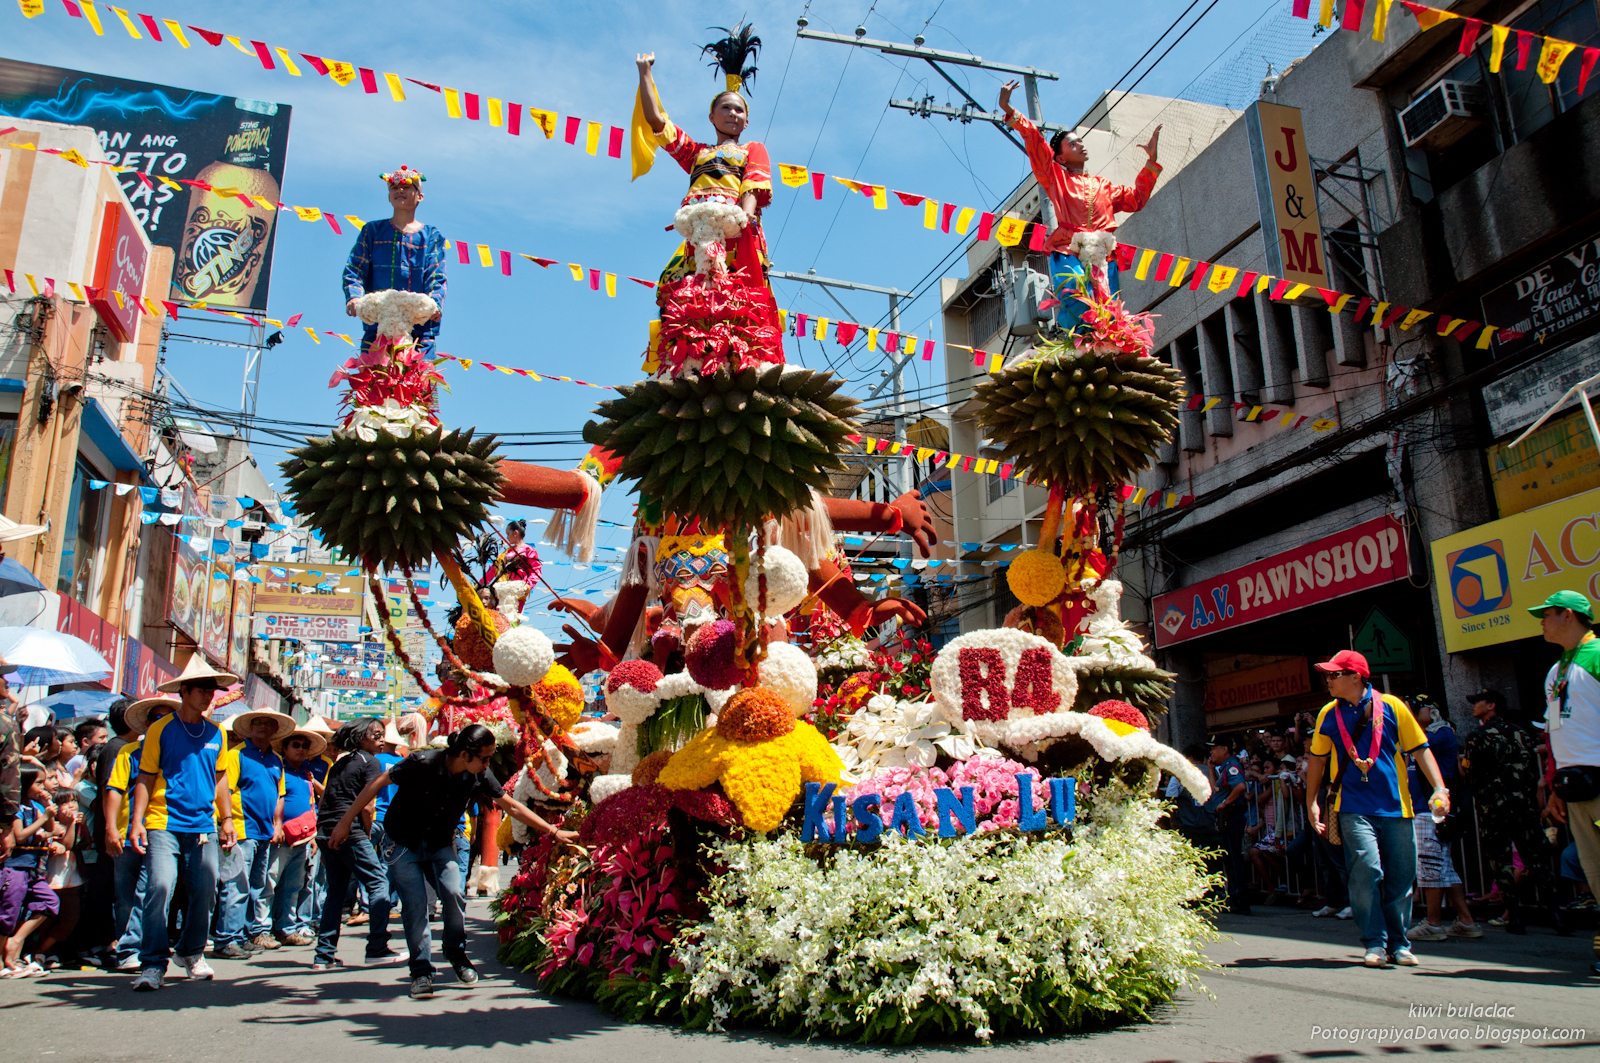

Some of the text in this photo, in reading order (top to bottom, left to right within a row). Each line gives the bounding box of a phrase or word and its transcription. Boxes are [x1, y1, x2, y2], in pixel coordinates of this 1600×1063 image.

[140, 135, 178, 147] ANG
[1275, 127, 1323, 275] J & M
[193, 226, 253, 298] STING
[1514, 264, 1555, 300] DE
[1531, 278, 1577, 313] Law
[1533, 302, 1600, 341] ATTORNEY
[1542, 306, 1555, 323] DE
[1554, 294, 1582, 316] VERA
[1577, 460, 1600, 477] PED
[1521, 510, 1600, 582] AC
[290, 582, 337, 596] Kdak
[1190, 526, 1400, 629] A.V. PAWNSHOP
[289, 595, 356, 609] EXPRESS
[265, 627, 348, 640] DEVELOPING
[1461, 613, 1511, 634] Since 1928
[1220, 673, 1310, 707] COMMERCIAL
